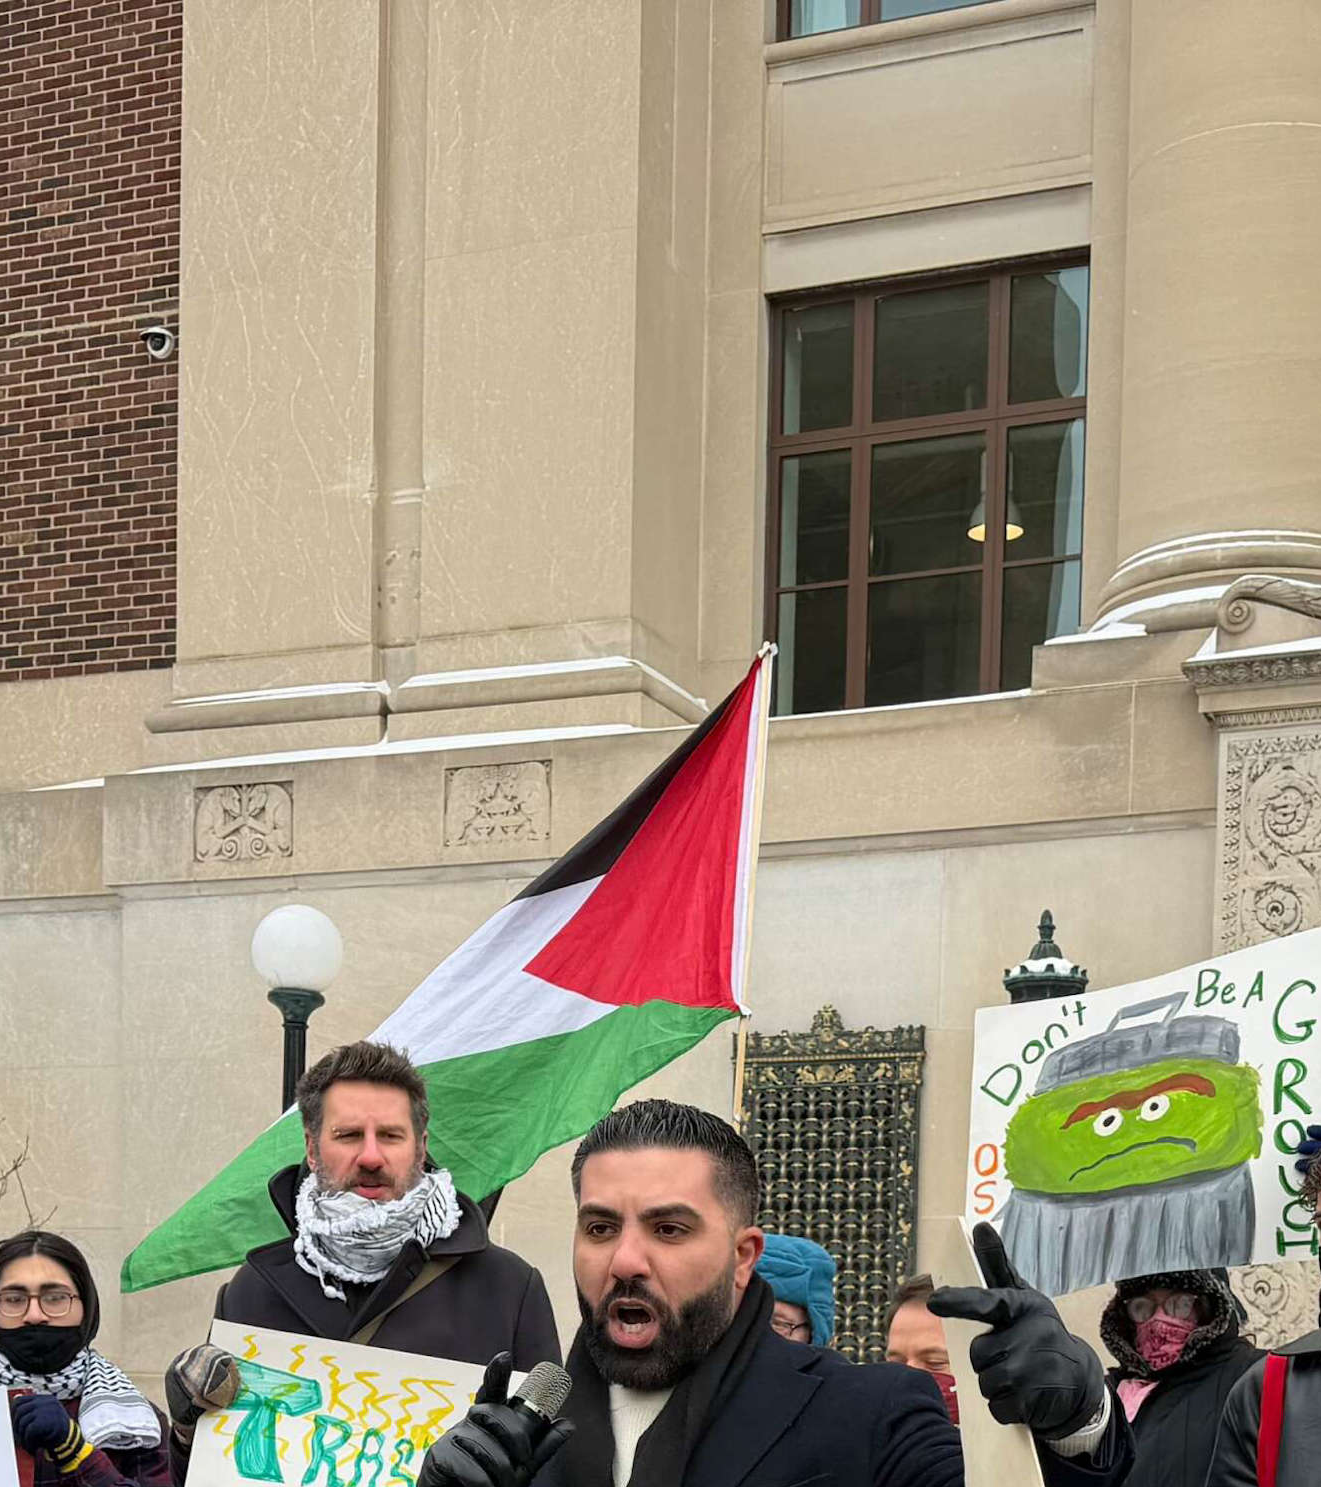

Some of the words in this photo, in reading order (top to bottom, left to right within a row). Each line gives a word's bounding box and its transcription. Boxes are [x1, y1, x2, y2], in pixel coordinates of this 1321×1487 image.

[981, 1001, 1086, 1107] Don't
[1195, 968, 1237, 1008] Be
[1242, 970, 1264, 1008] A
